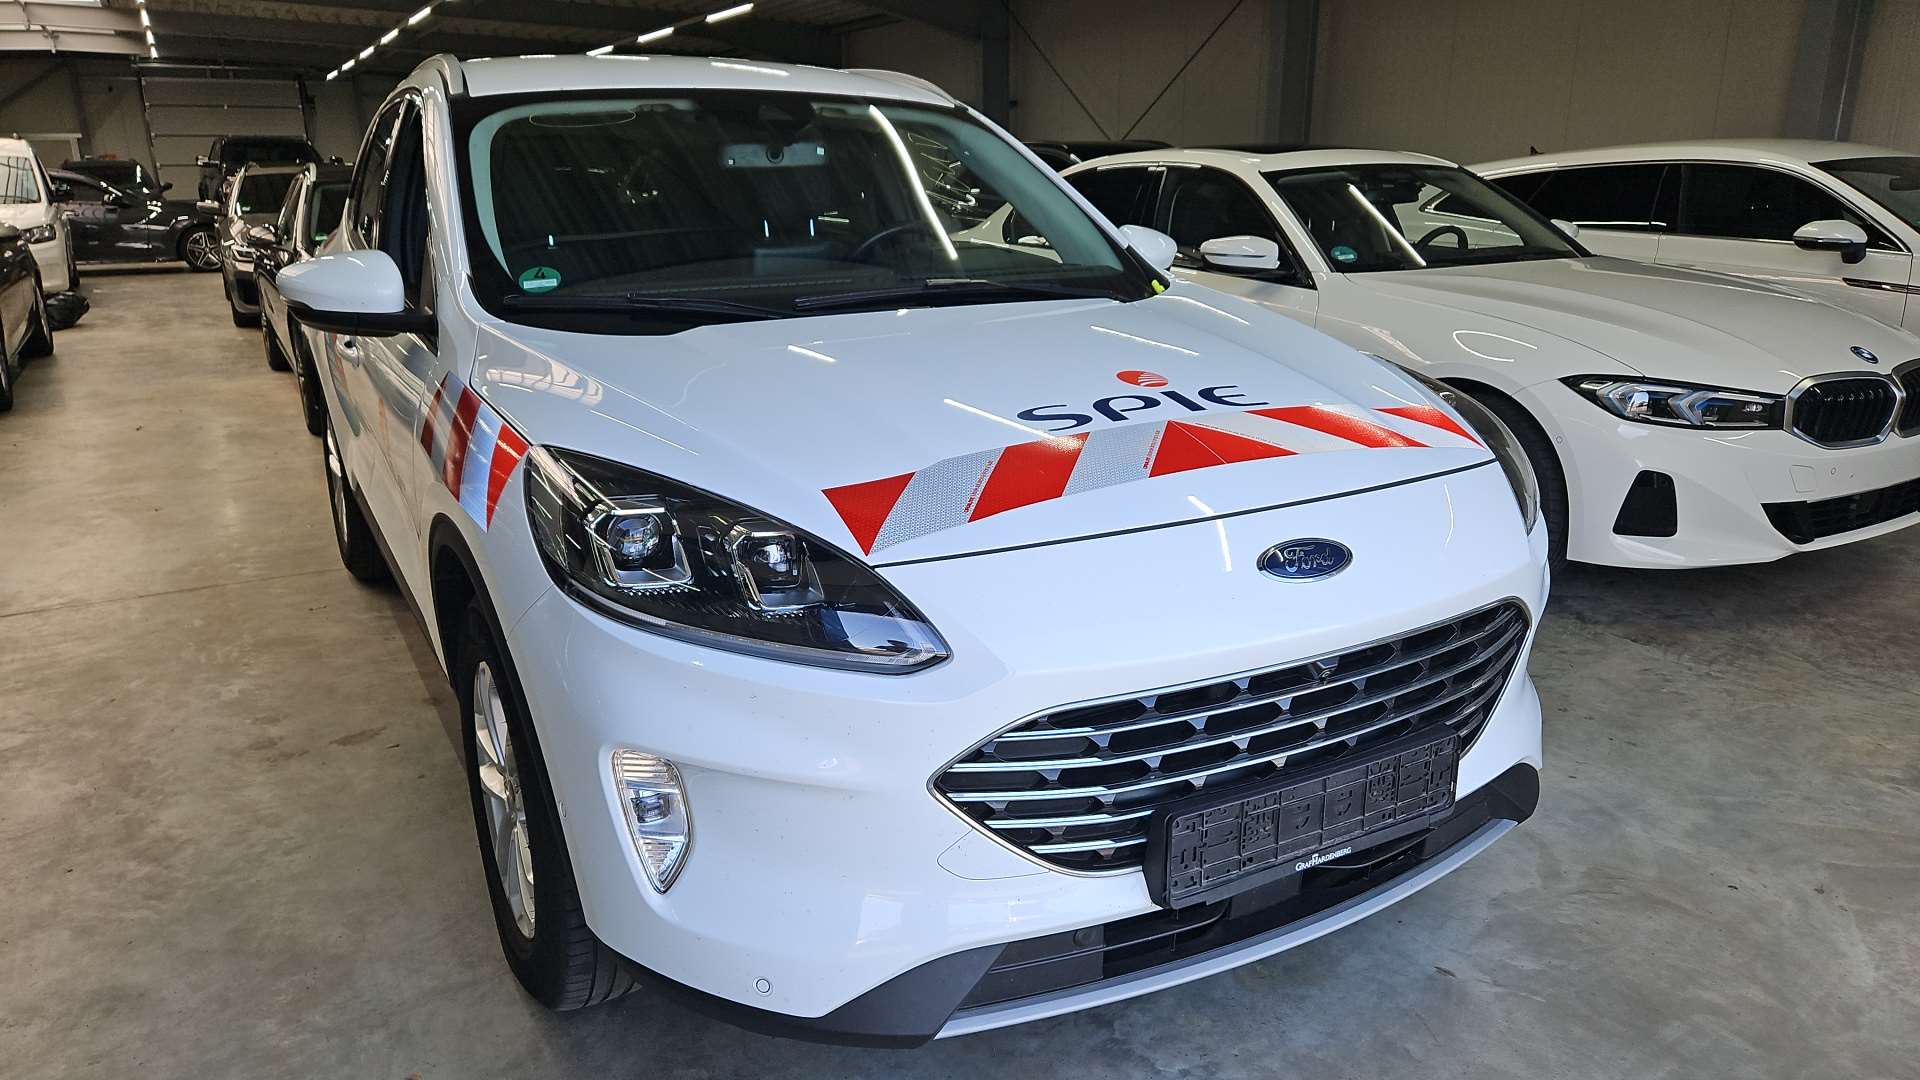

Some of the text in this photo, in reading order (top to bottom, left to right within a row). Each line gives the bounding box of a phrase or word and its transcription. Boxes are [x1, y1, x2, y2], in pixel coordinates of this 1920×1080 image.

[534, 267, 546, 279] 4
[1016, 385, 1270, 432] SPIE
[1283, 544, 1335, 573] Ford
